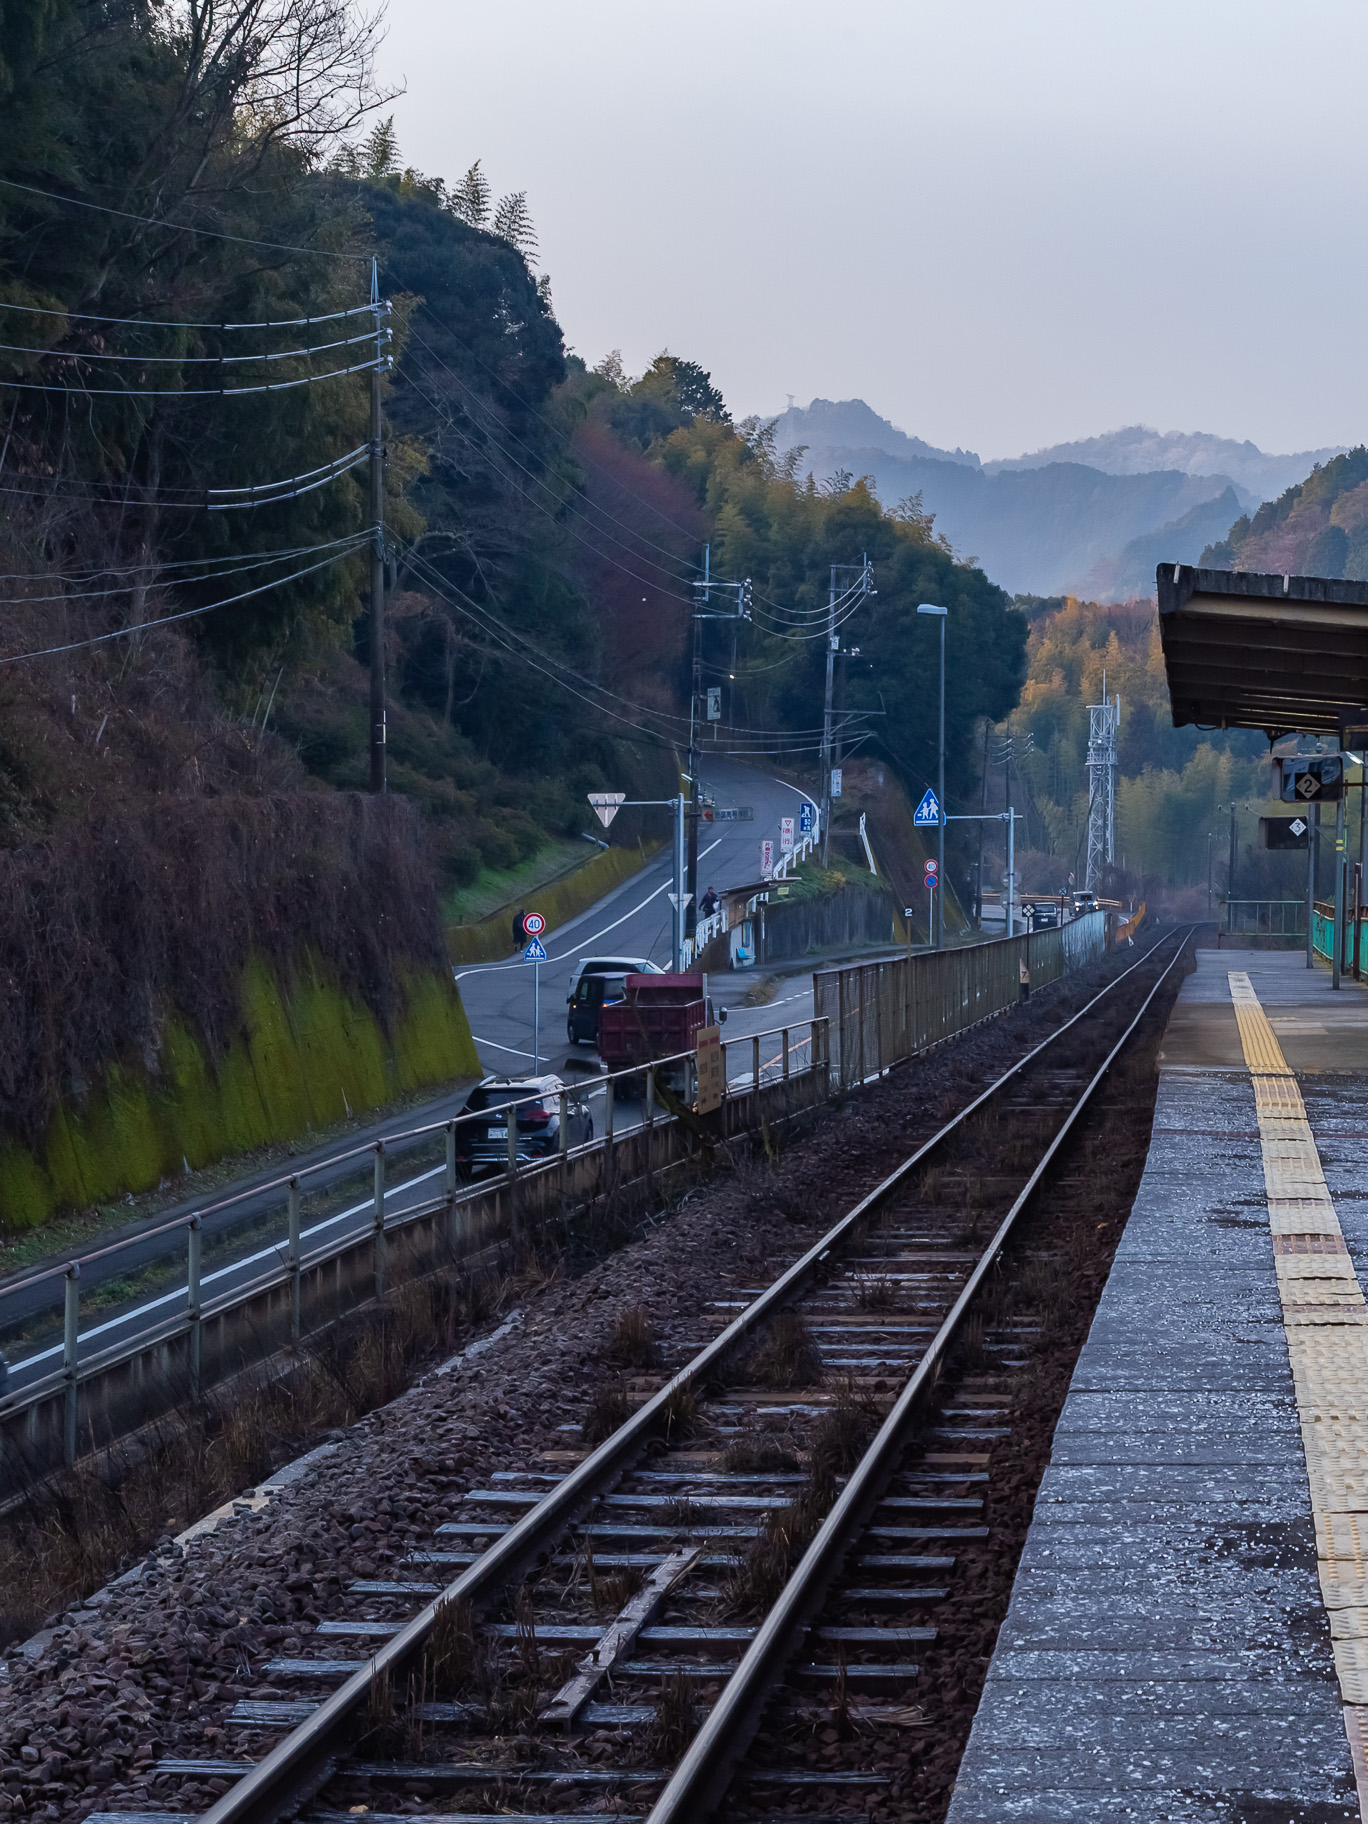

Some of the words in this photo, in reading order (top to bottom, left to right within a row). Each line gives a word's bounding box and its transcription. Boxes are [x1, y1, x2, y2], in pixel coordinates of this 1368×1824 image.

[1303, 778, 1313, 794] 2
[1294, 822, 1302, 833] 3
[904, 907, 913, 917] 2
[528, 919, 541, 929] 40
